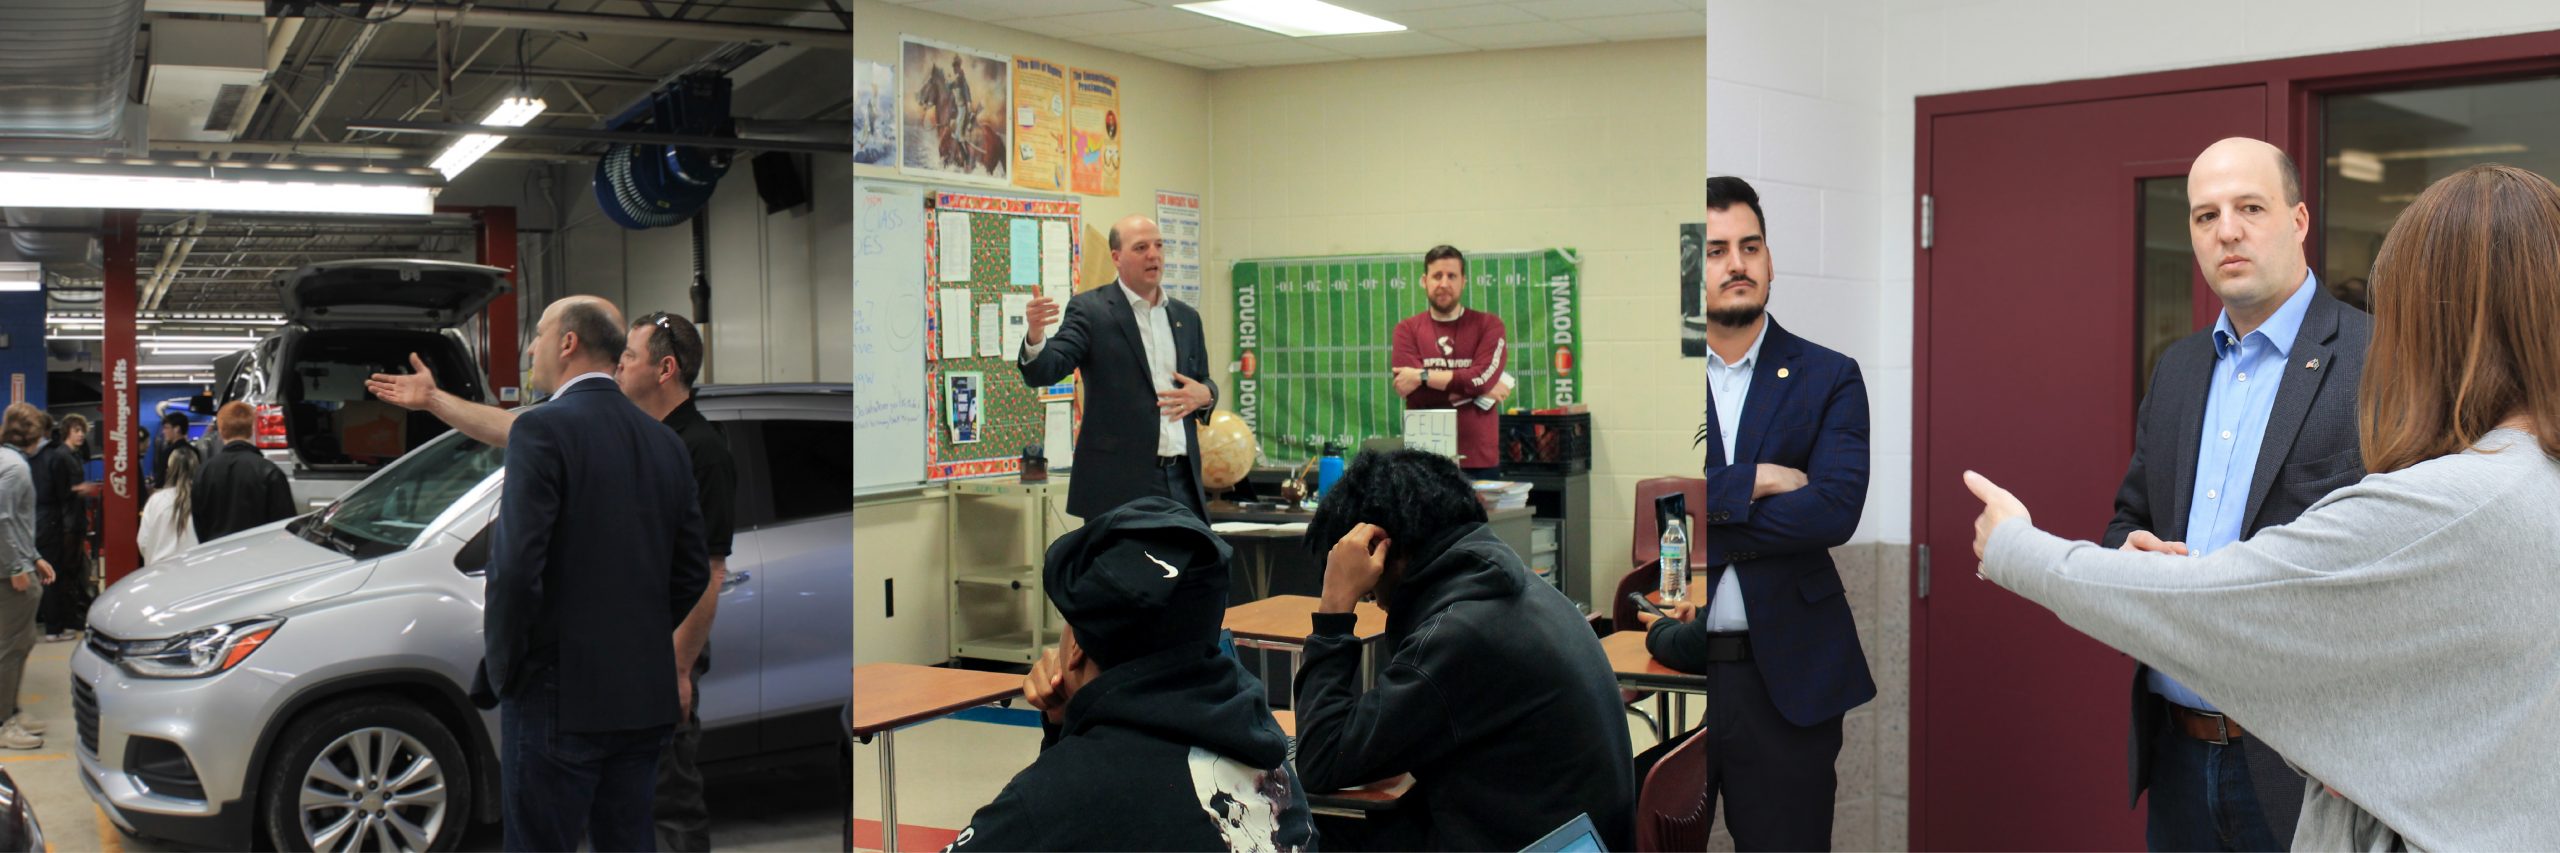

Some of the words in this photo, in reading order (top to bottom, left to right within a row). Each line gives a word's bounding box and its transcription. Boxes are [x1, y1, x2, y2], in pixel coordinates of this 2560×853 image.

[1239, 285, 1256, 348] TOUCH
[112, 358, 127, 390] Lifts
[110, 390, 131, 472] Challenger
[1405, 414, 1452, 436] CELL
